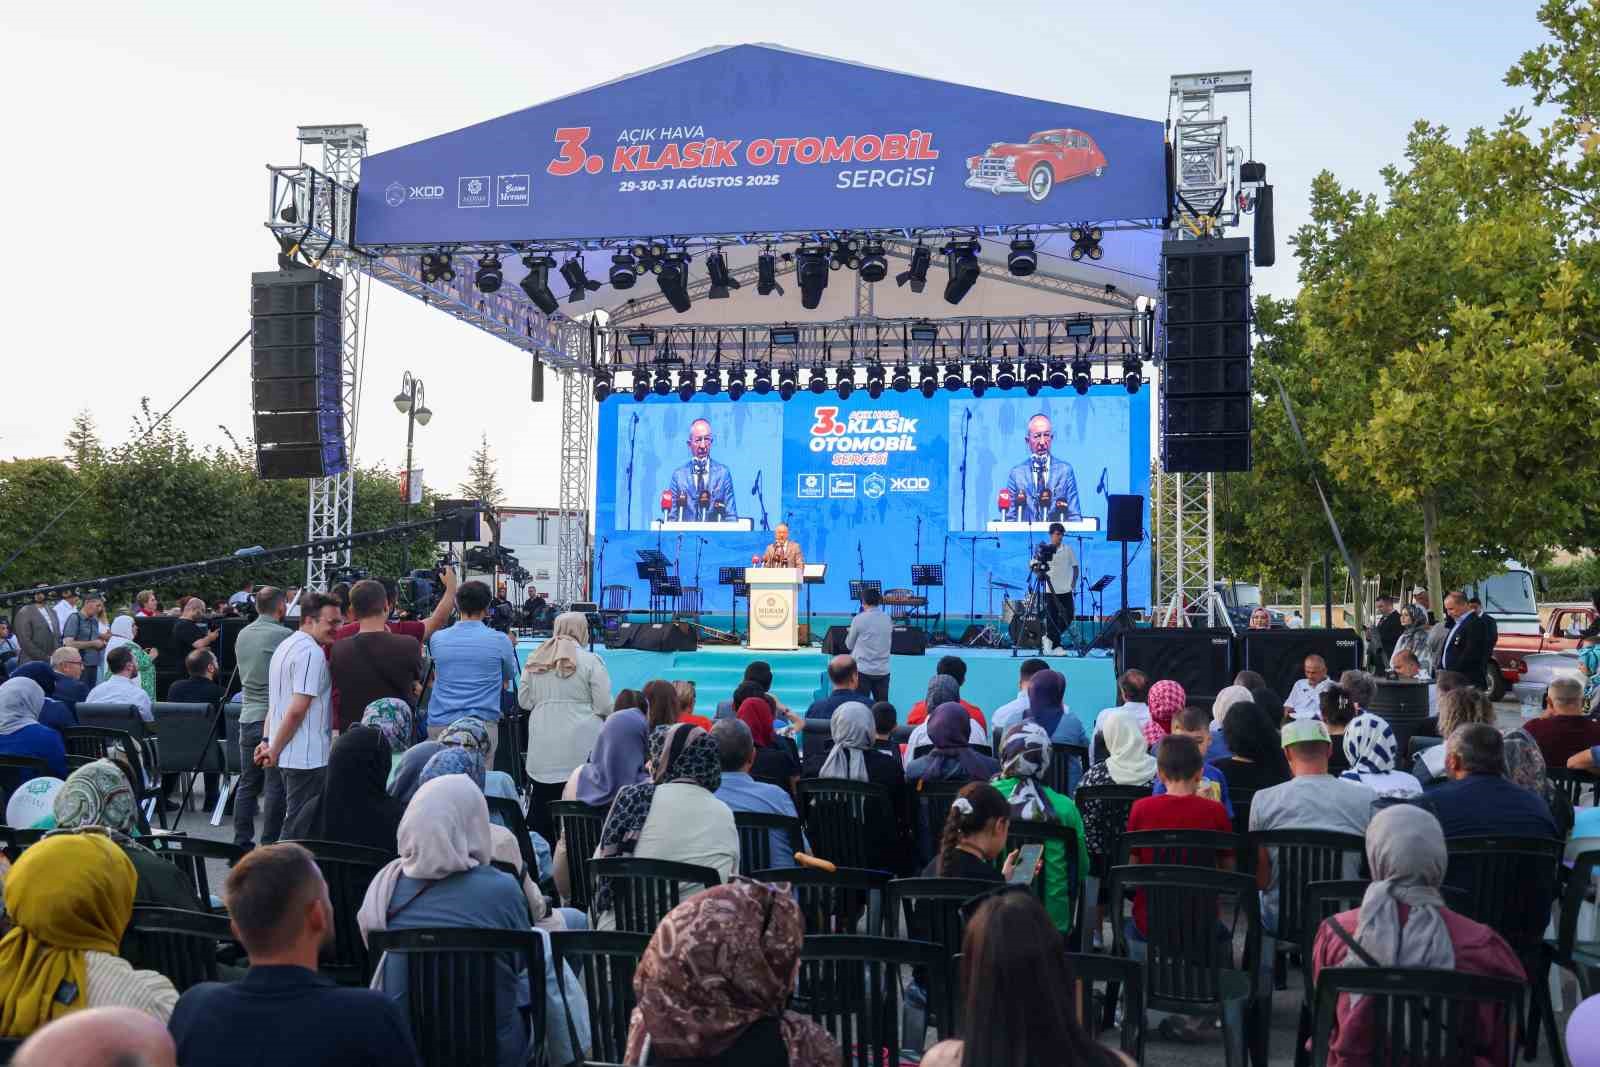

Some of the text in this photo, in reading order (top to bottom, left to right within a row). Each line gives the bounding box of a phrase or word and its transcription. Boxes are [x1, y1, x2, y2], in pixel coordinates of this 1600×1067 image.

[617, 126, 704, 144] AÇIK HAVA
[547, 126, 604, 177] 3.
[619, 173, 781, 192] 29-30-31 AĞUSTOS 2025
[810, 406, 846, 436] 3.
